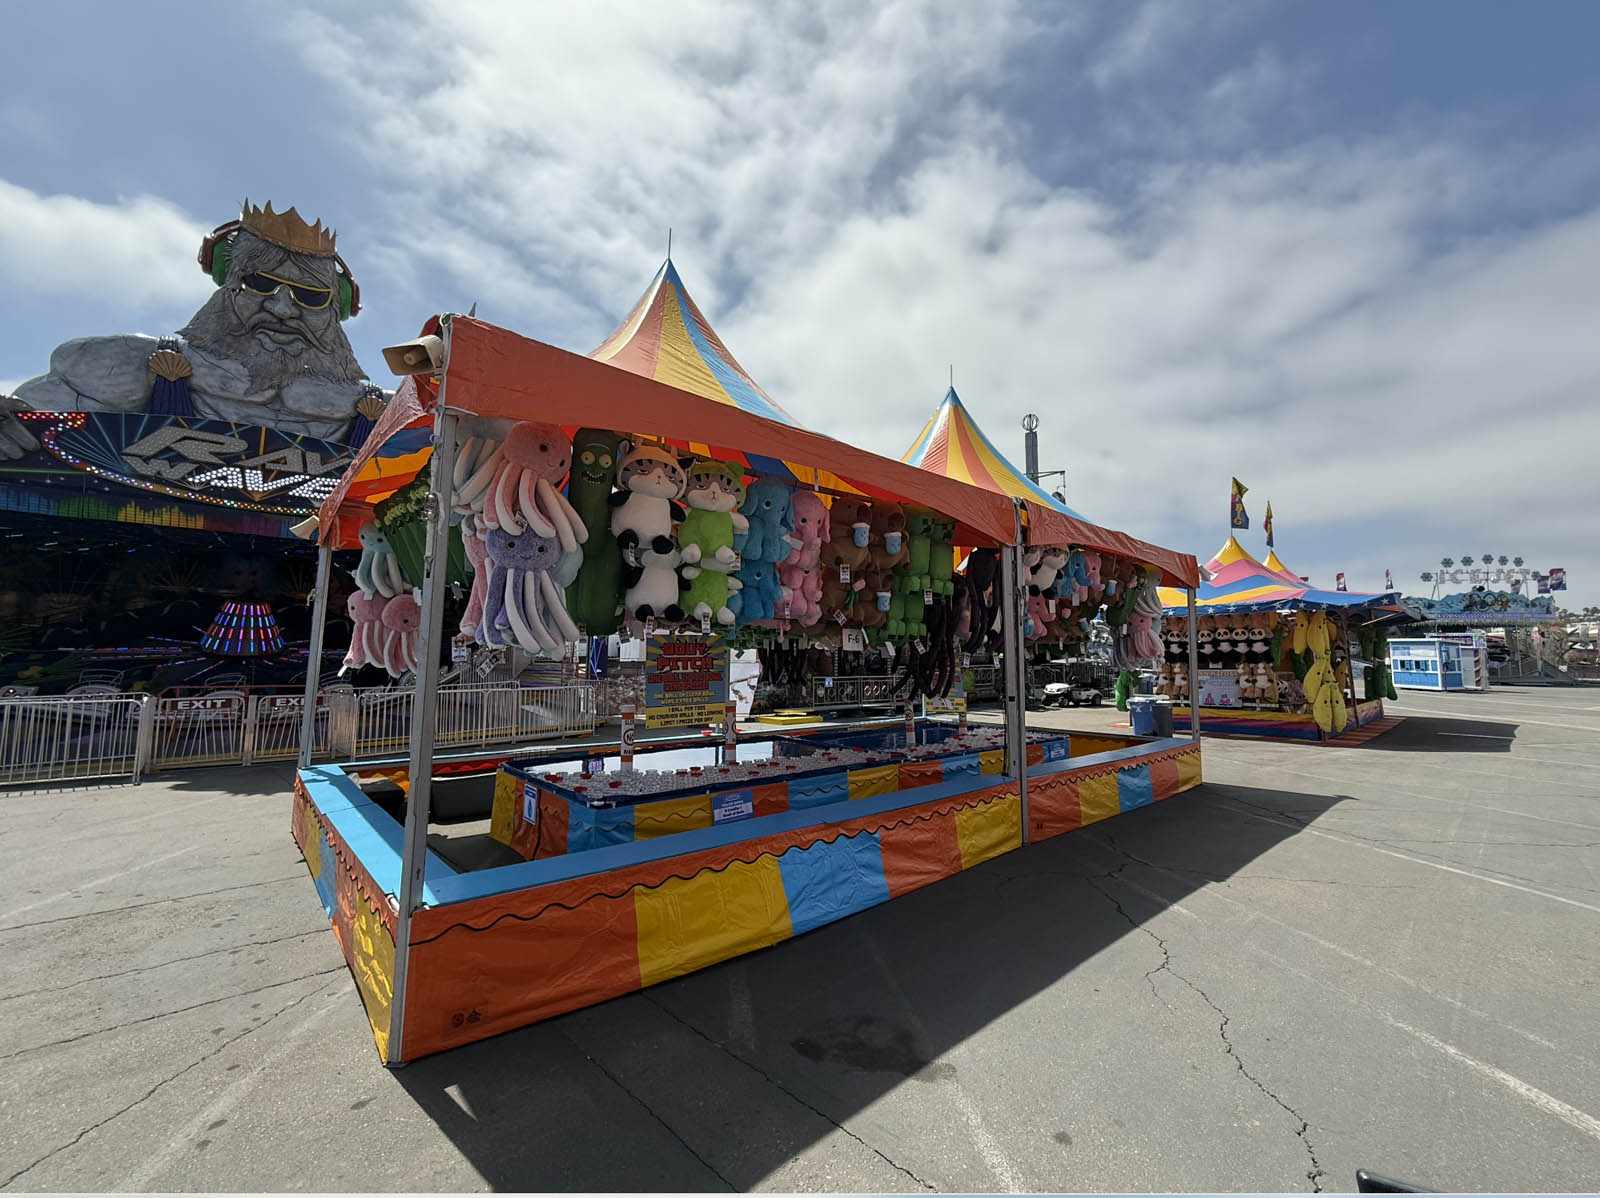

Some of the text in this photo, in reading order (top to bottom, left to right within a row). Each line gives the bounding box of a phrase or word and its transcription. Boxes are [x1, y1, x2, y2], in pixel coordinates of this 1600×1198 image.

[122, 426, 354, 476] RAV
[1439, 568, 1482, 585] ICE
[1490, 567, 1531, 585] JET
[656, 656, 714, 672] PITCH
[177, 699, 227, 710] EXIT
[276, 697, 305, 707] EXI
